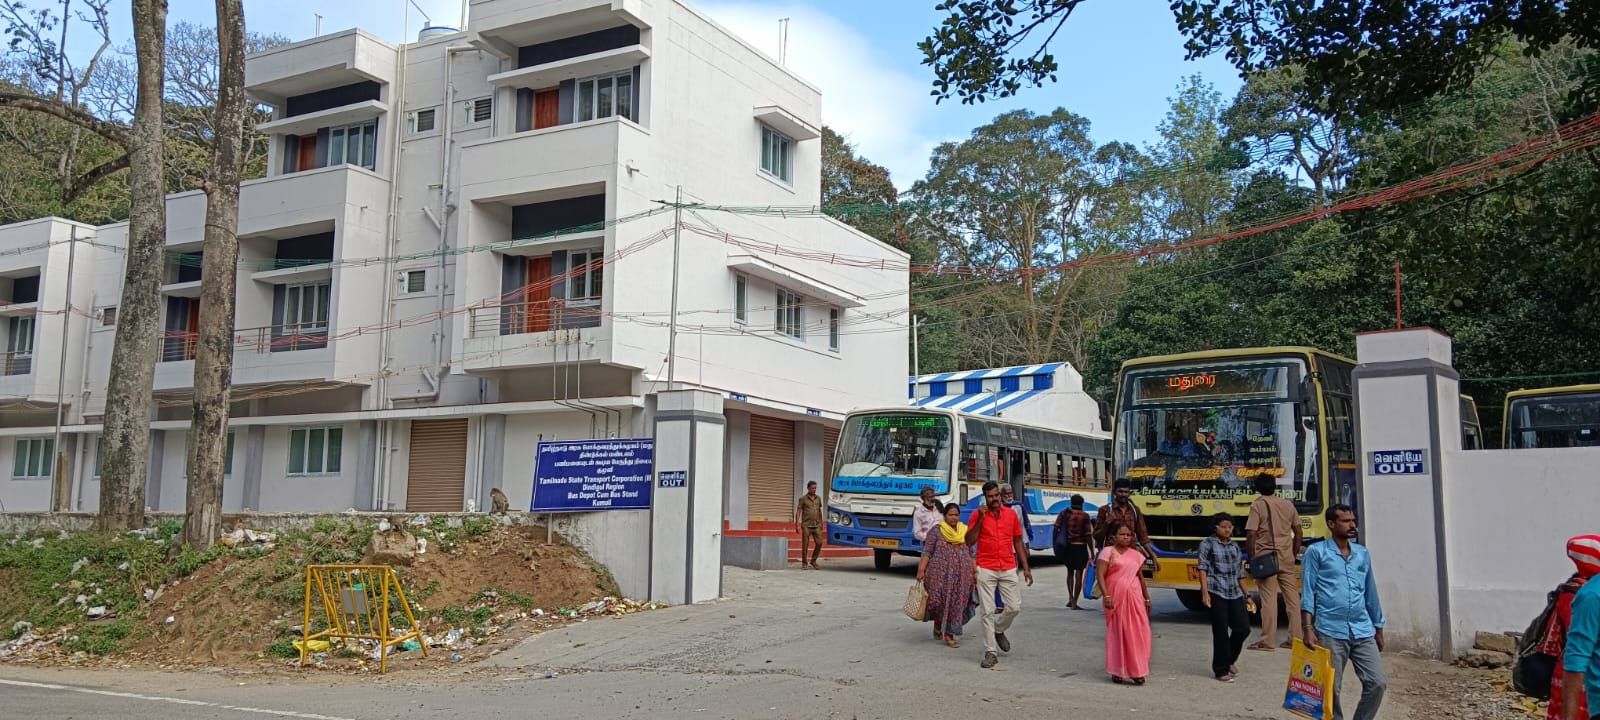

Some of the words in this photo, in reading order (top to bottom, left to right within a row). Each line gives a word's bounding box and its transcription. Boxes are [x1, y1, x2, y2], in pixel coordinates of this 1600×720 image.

[1168, 374, 1216, 390] மதுரை
[541, 444, 568, 453] தமிழ்நாடு
[1374, 451, 1422, 463] வெளியே
[1379, 463, 1417, 474] OUT
[568, 476, 582, 484] State
[584, 475, 610, 485] Transport
[611, 474, 643, 484] Corporation
[662, 479, 682, 487] OUT
[583, 483, 604, 492] Dindigul
[605, 482, 624, 491] Region
[568, 491, 578, 499] Bus
[580, 491, 595, 501] Depot
[611, 490, 620, 498] Bus
[622, 490, 638, 498] Stand
